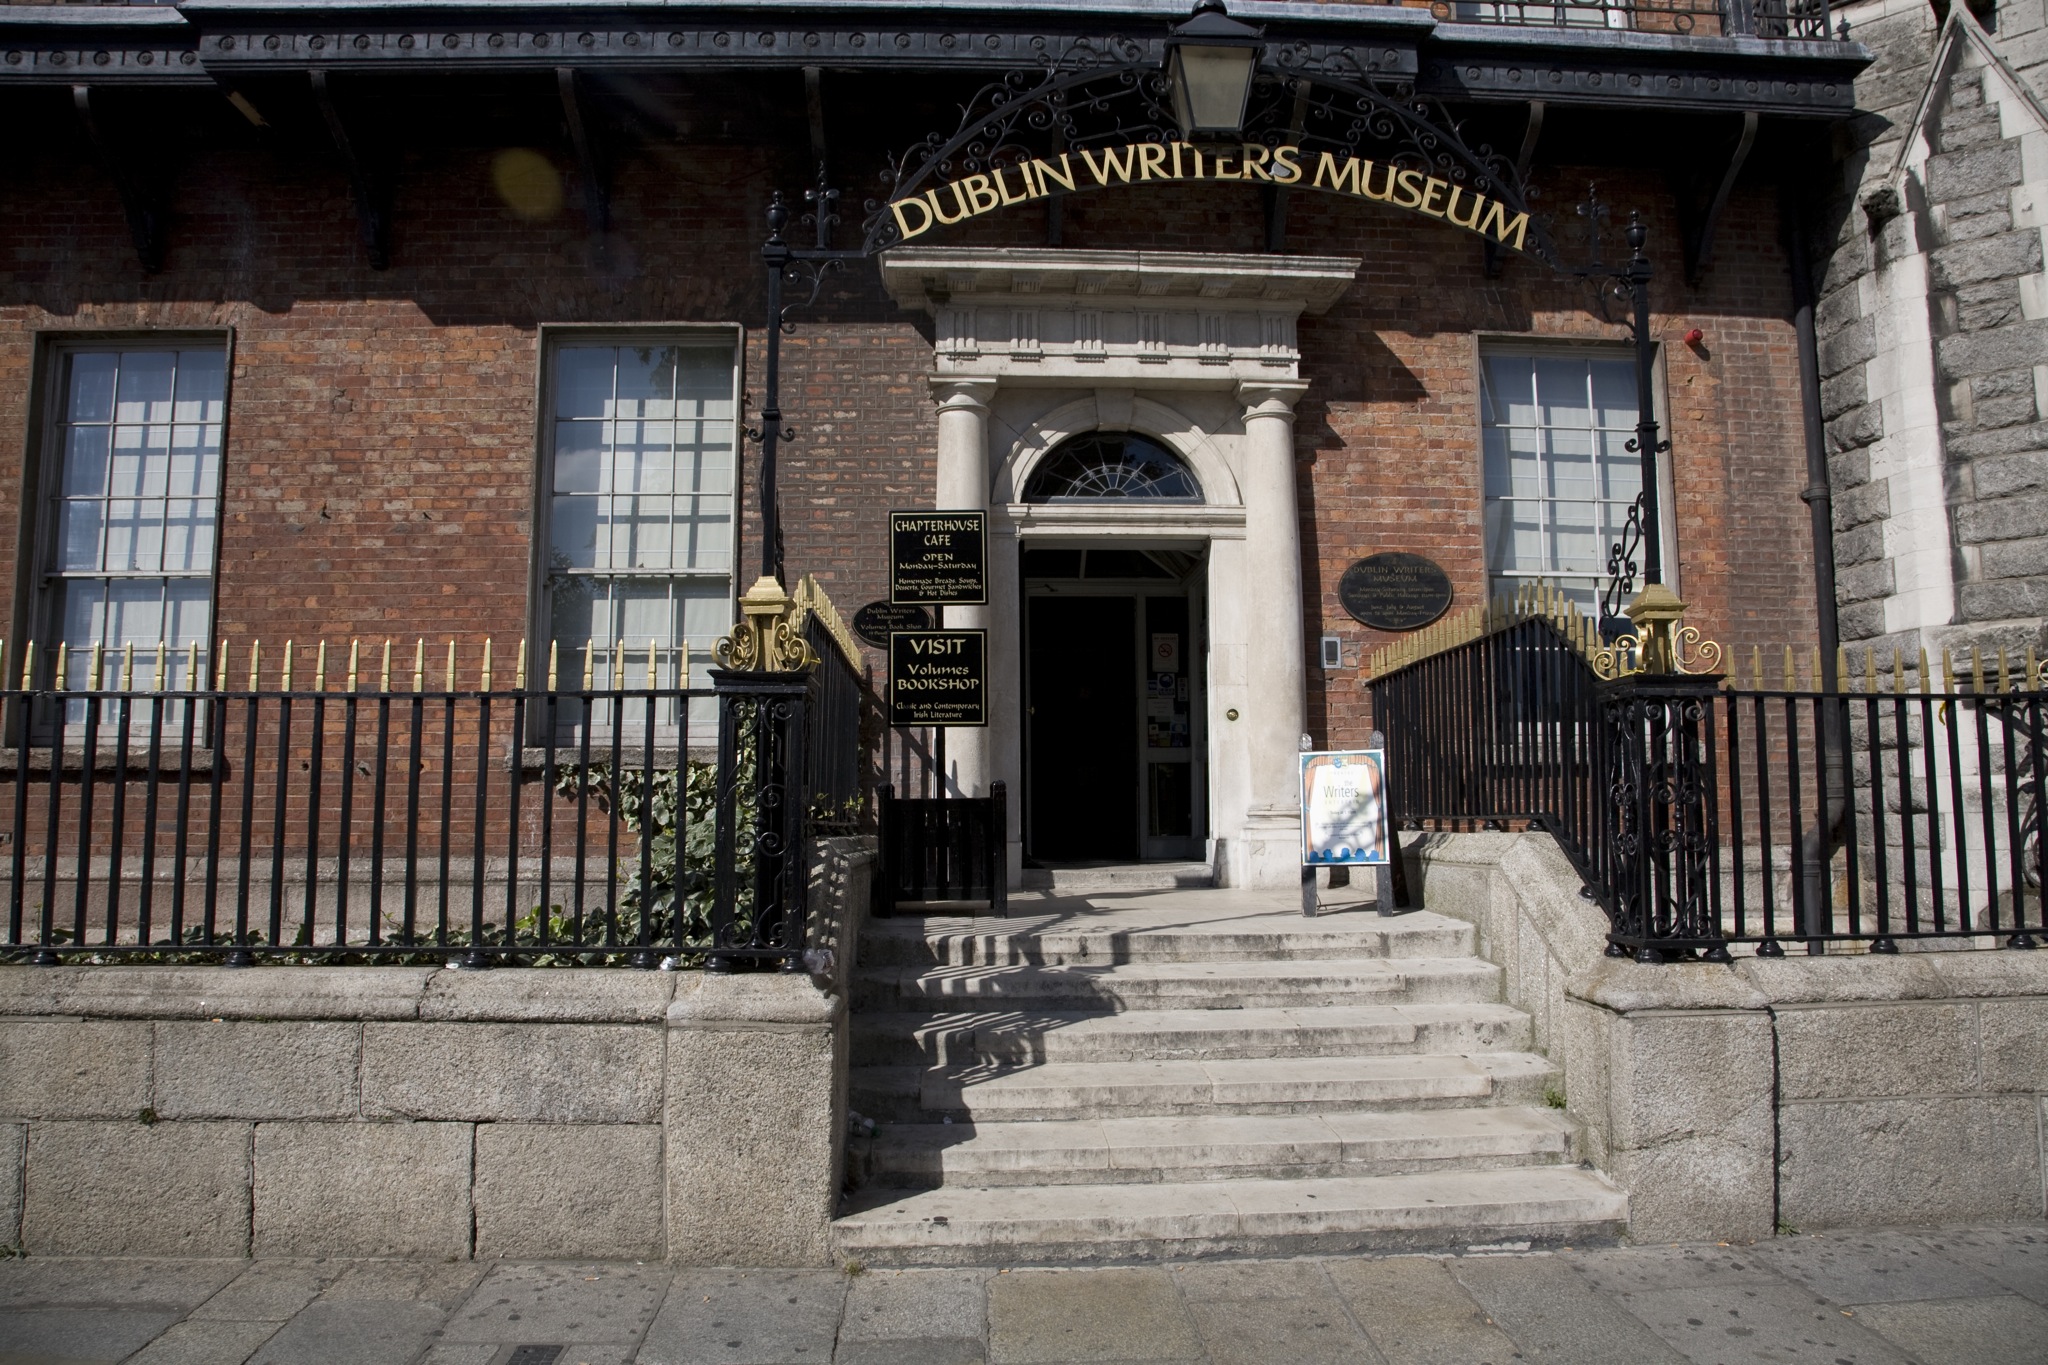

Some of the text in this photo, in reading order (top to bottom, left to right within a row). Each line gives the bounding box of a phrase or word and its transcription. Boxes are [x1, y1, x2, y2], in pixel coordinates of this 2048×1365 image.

[890, 142, 1530, 252] DUBLIN WRITERS MUSEUM
[924, 534, 951, 546] CAFE
[922, 553, 954, 561] OPEN
[909, 638, 967, 655] VISIT
[907, 662, 969, 675] Volumes
[896, 678, 980, 690] BOOKSHOP
[919, 702, 932, 710] and
[934, 702, 980, 711] Contemporary
[913, 710, 928, 718] Irish
[1323, 785, 1360, 798] Writers
